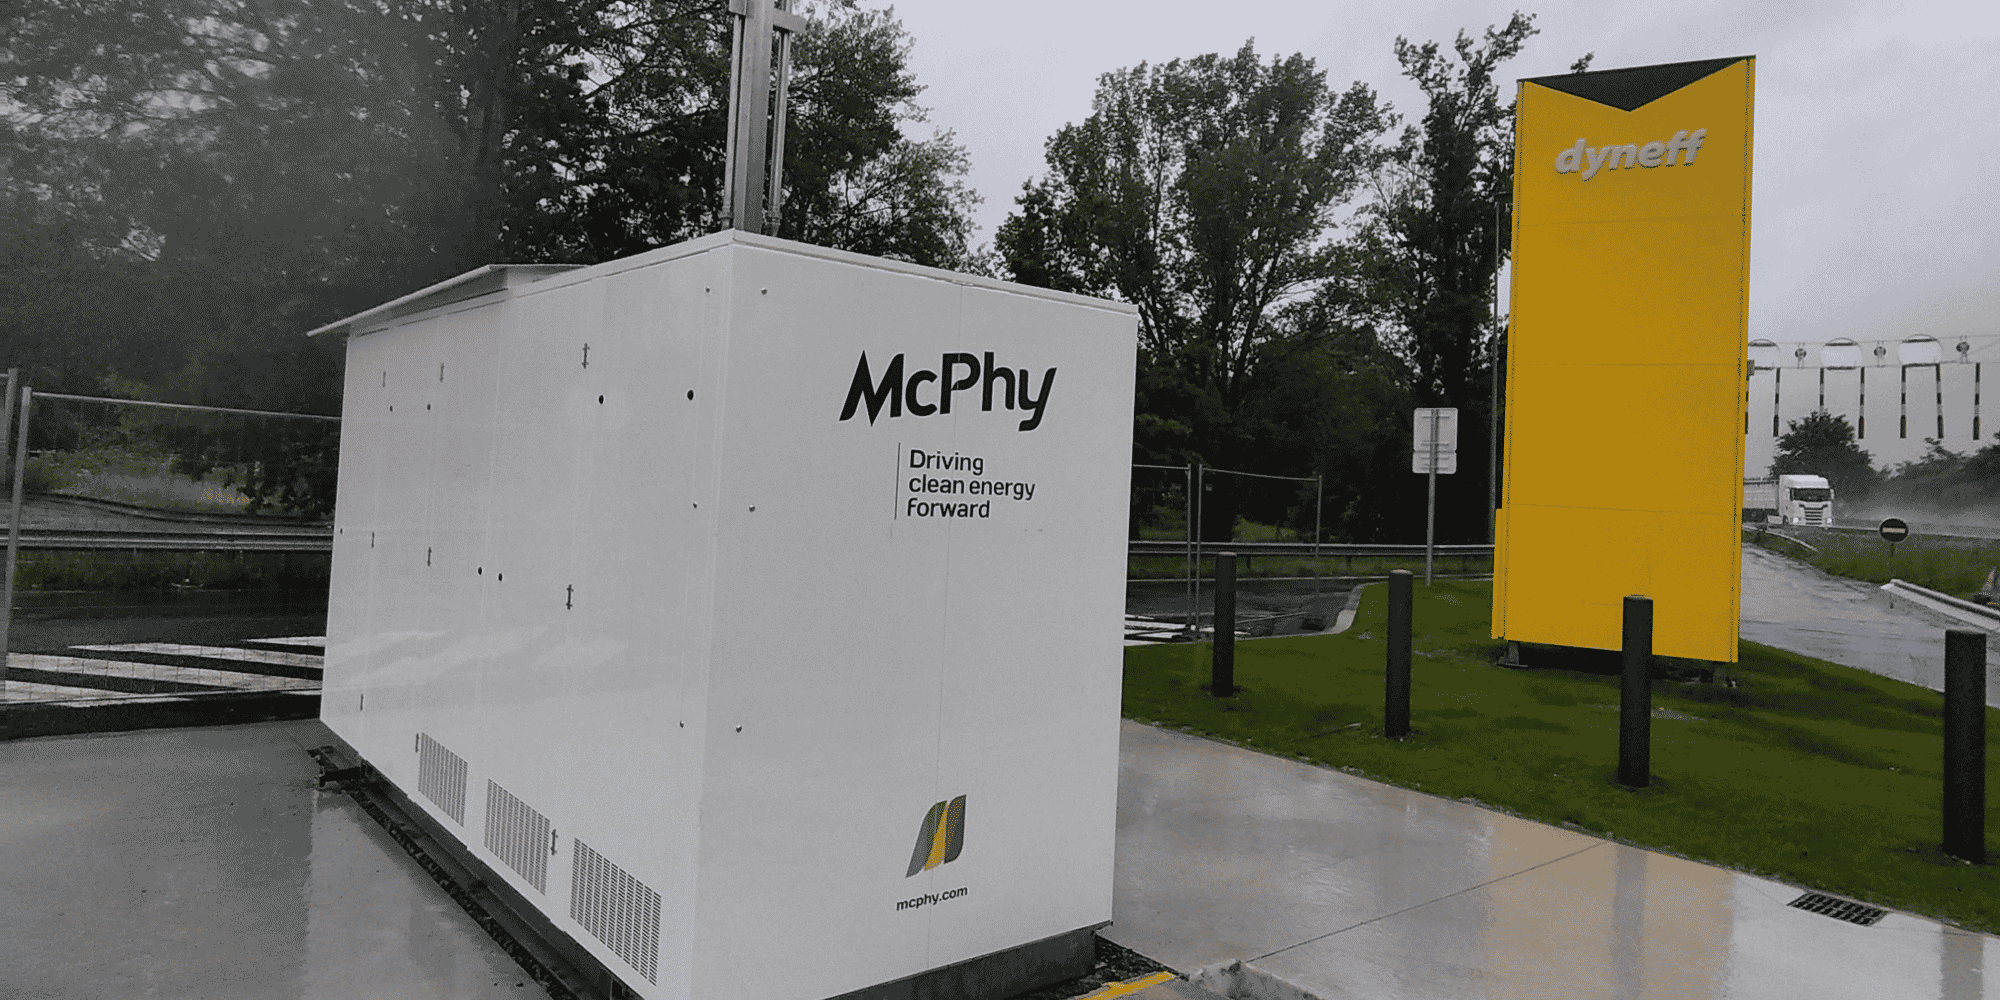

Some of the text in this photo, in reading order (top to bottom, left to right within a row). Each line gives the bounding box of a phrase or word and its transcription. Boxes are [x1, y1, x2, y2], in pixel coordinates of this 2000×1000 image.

[1554, 127, 1707, 181] dyneff
[839, 349, 1057, 432] McPhy
[909, 449, 984, 476] Driving
[908, 474, 1036, 501] clean energy
[907, 497, 990, 518] forward
[896, 886, 968, 911] mcphy.com
